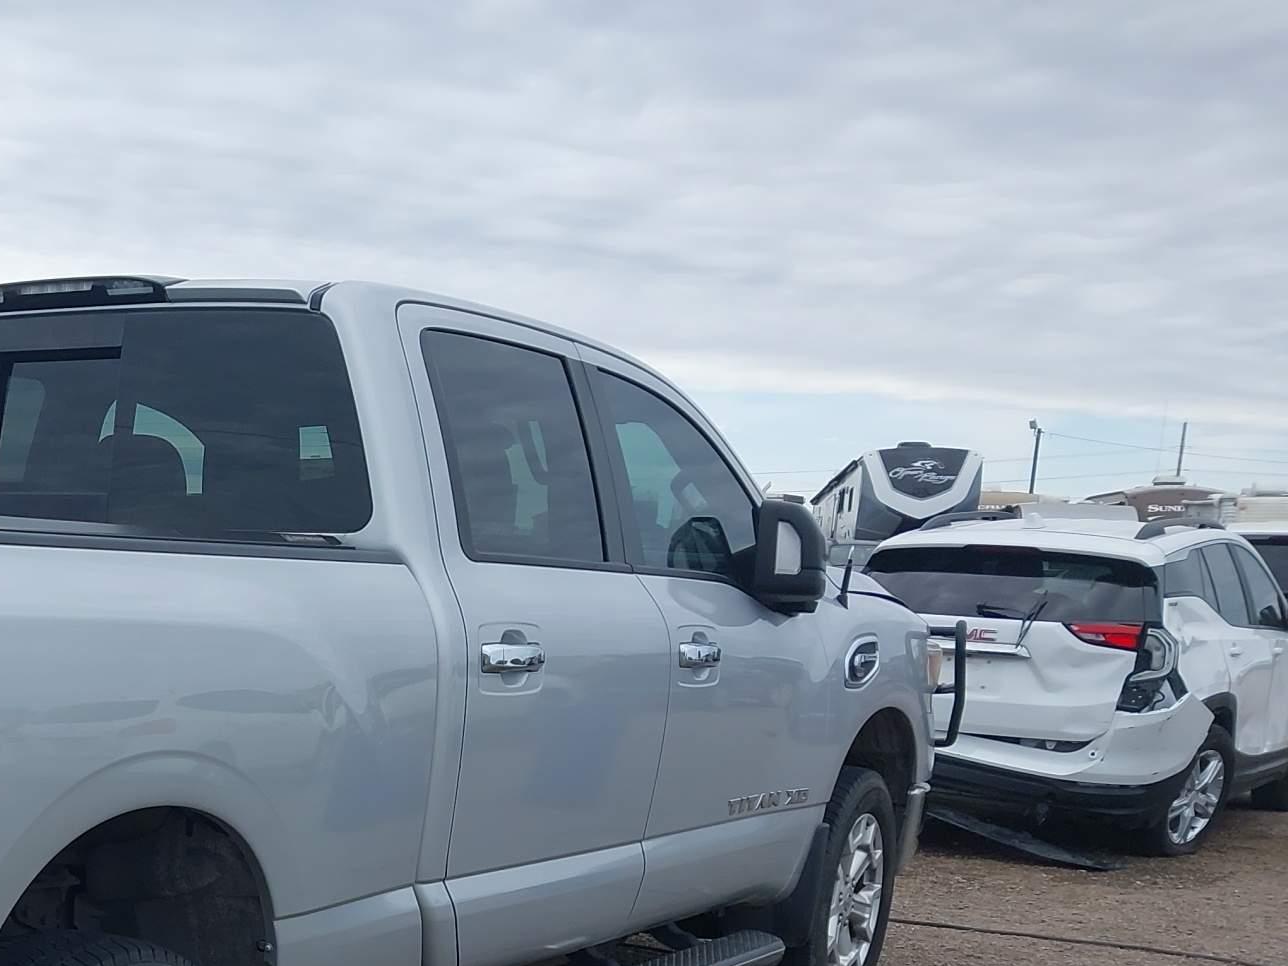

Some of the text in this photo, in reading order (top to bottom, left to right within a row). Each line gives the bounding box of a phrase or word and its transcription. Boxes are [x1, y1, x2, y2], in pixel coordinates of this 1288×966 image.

[1147, 504, 1186, 512] SUND
[967, 628, 998, 641] MC
[727, 790, 782, 816] TITAN
